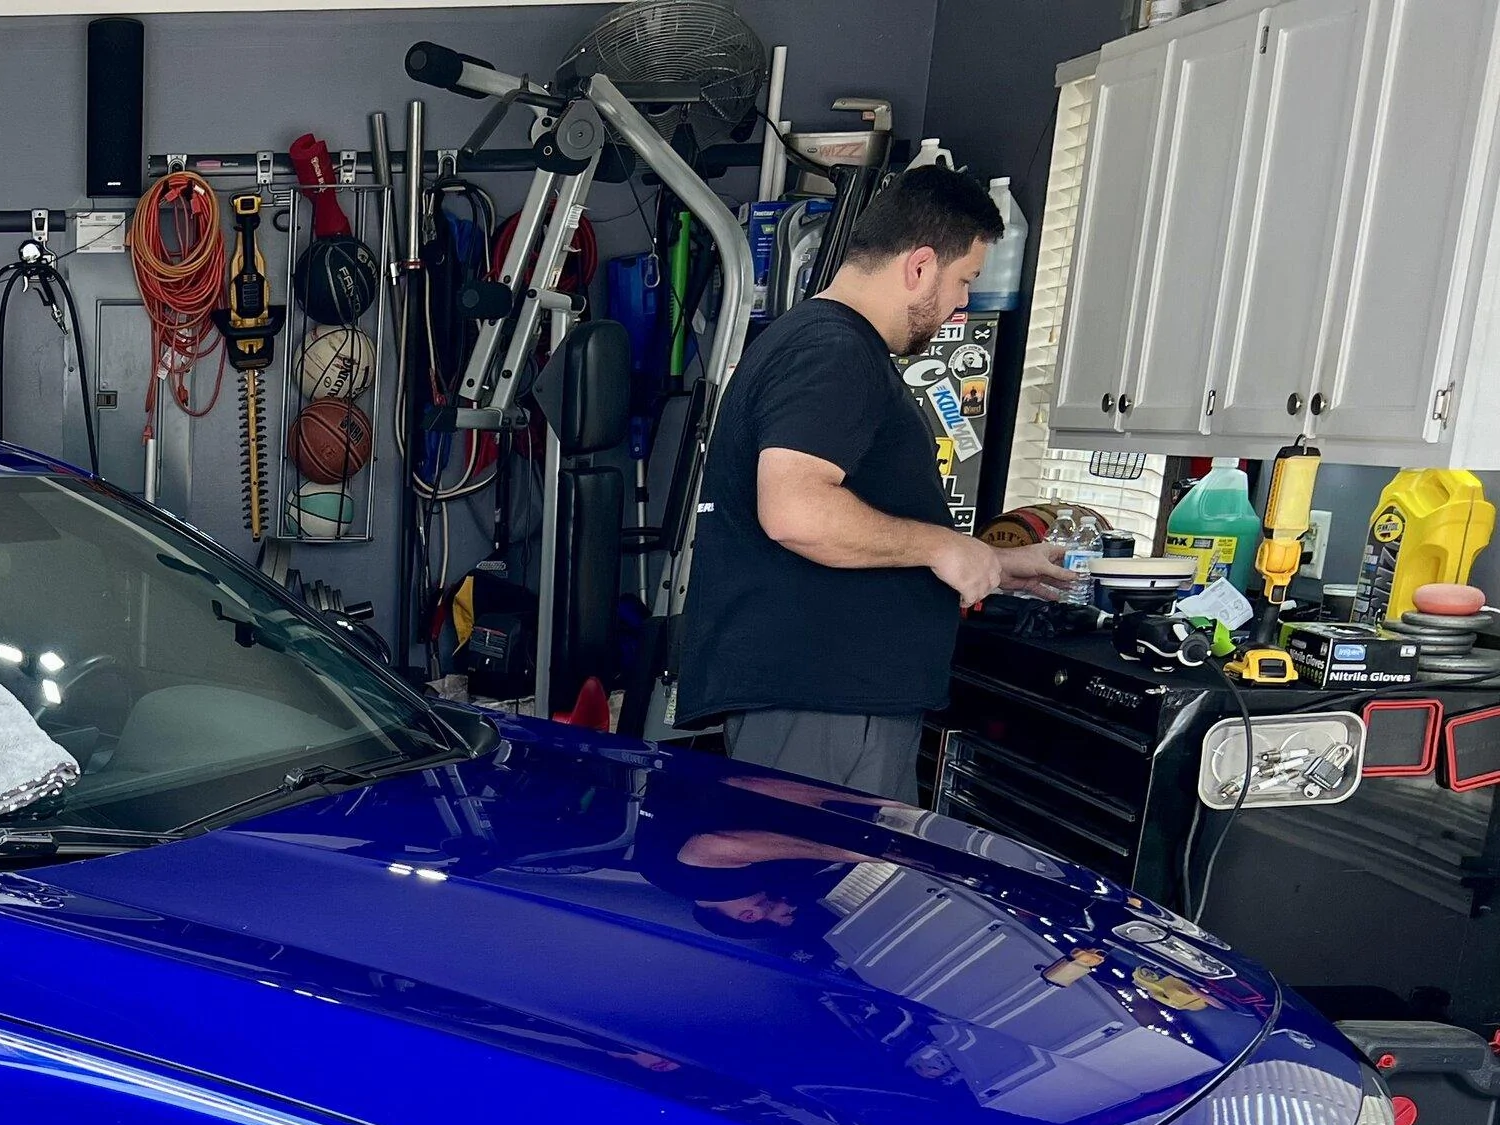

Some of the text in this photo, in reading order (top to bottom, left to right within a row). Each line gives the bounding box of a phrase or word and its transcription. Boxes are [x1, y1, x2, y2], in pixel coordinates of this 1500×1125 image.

[937, 327, 961, 339] ETI
[1329, 671, 1411, 683] Nitrile Gloves
